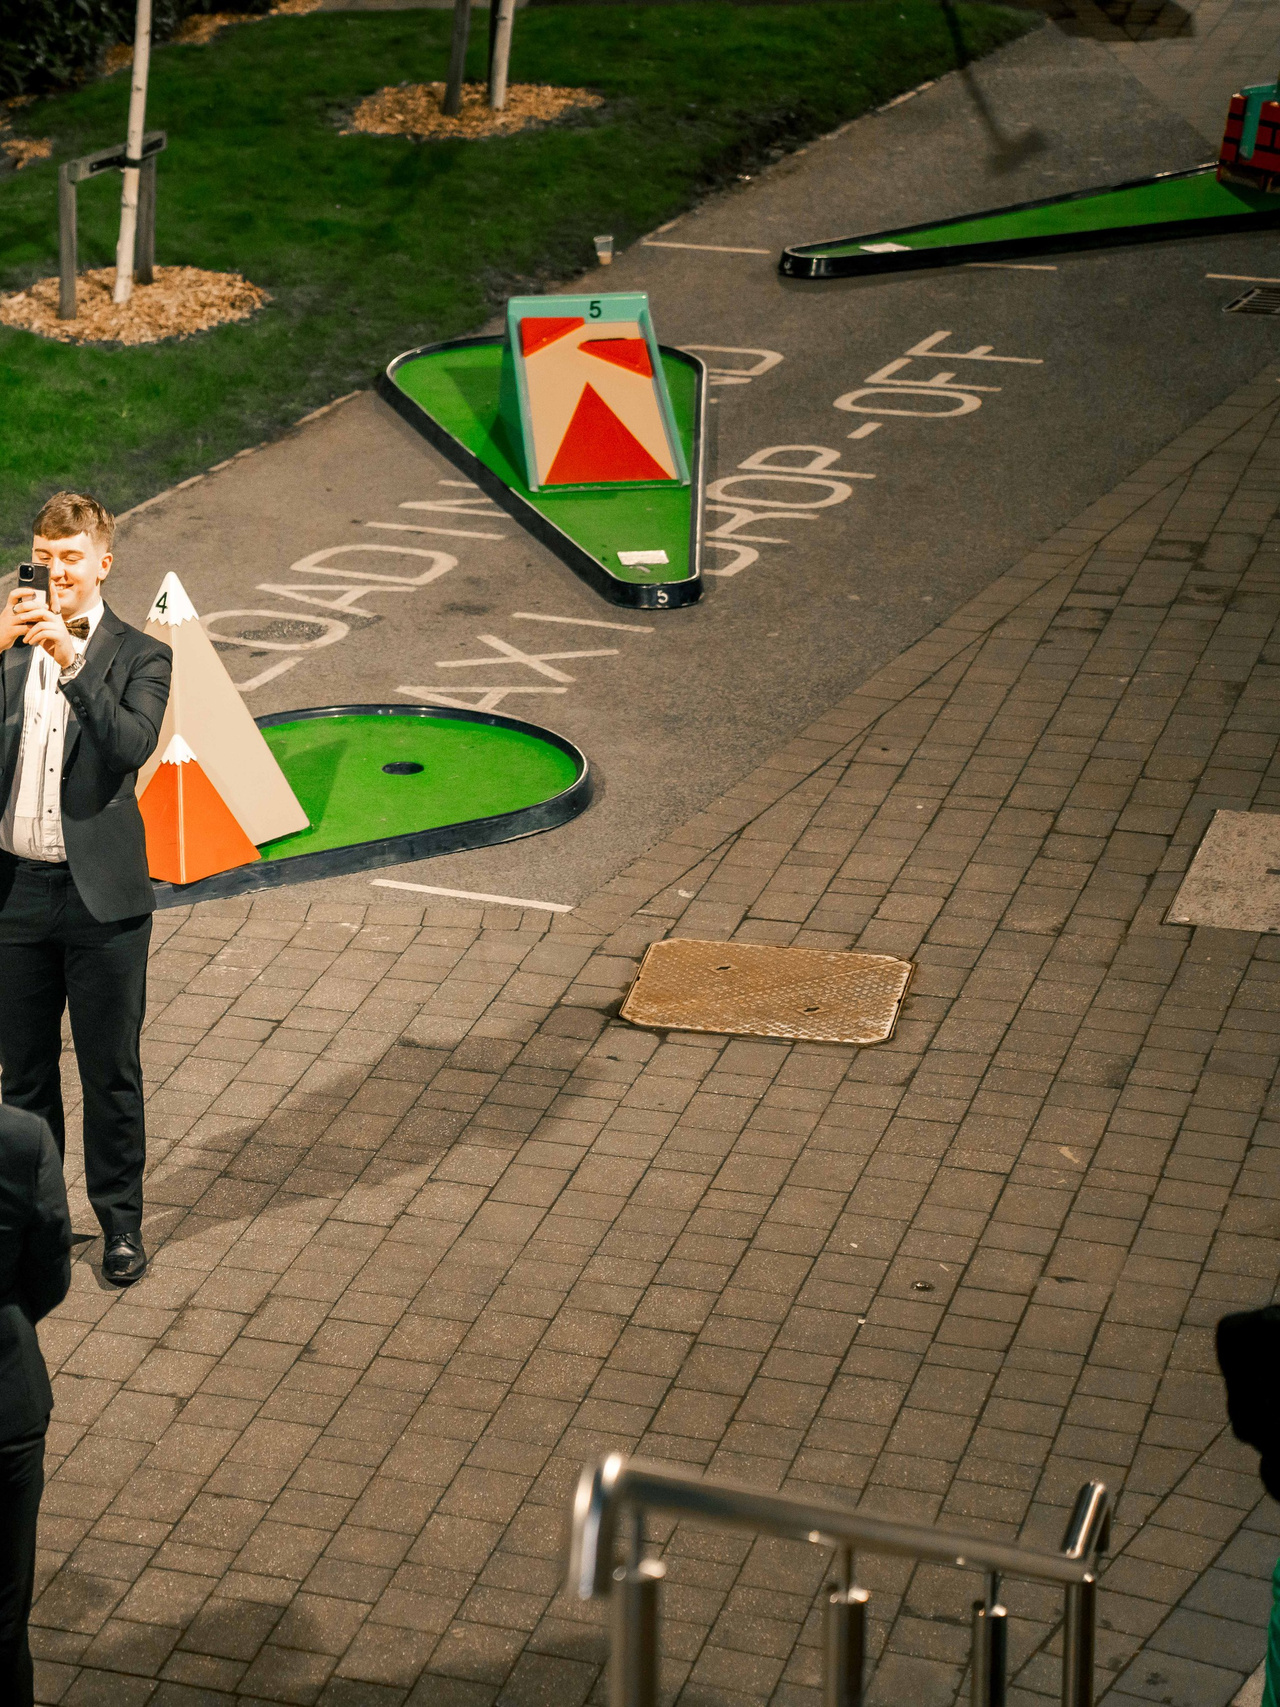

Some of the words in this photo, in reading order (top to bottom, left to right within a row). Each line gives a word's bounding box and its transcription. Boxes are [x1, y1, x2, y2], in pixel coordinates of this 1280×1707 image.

[589, 300, 602, 319] 5
[155, 591, 168, 614] 4
[657, 589, 669, 604] 5
[393, 612, 655, 717] AXI
